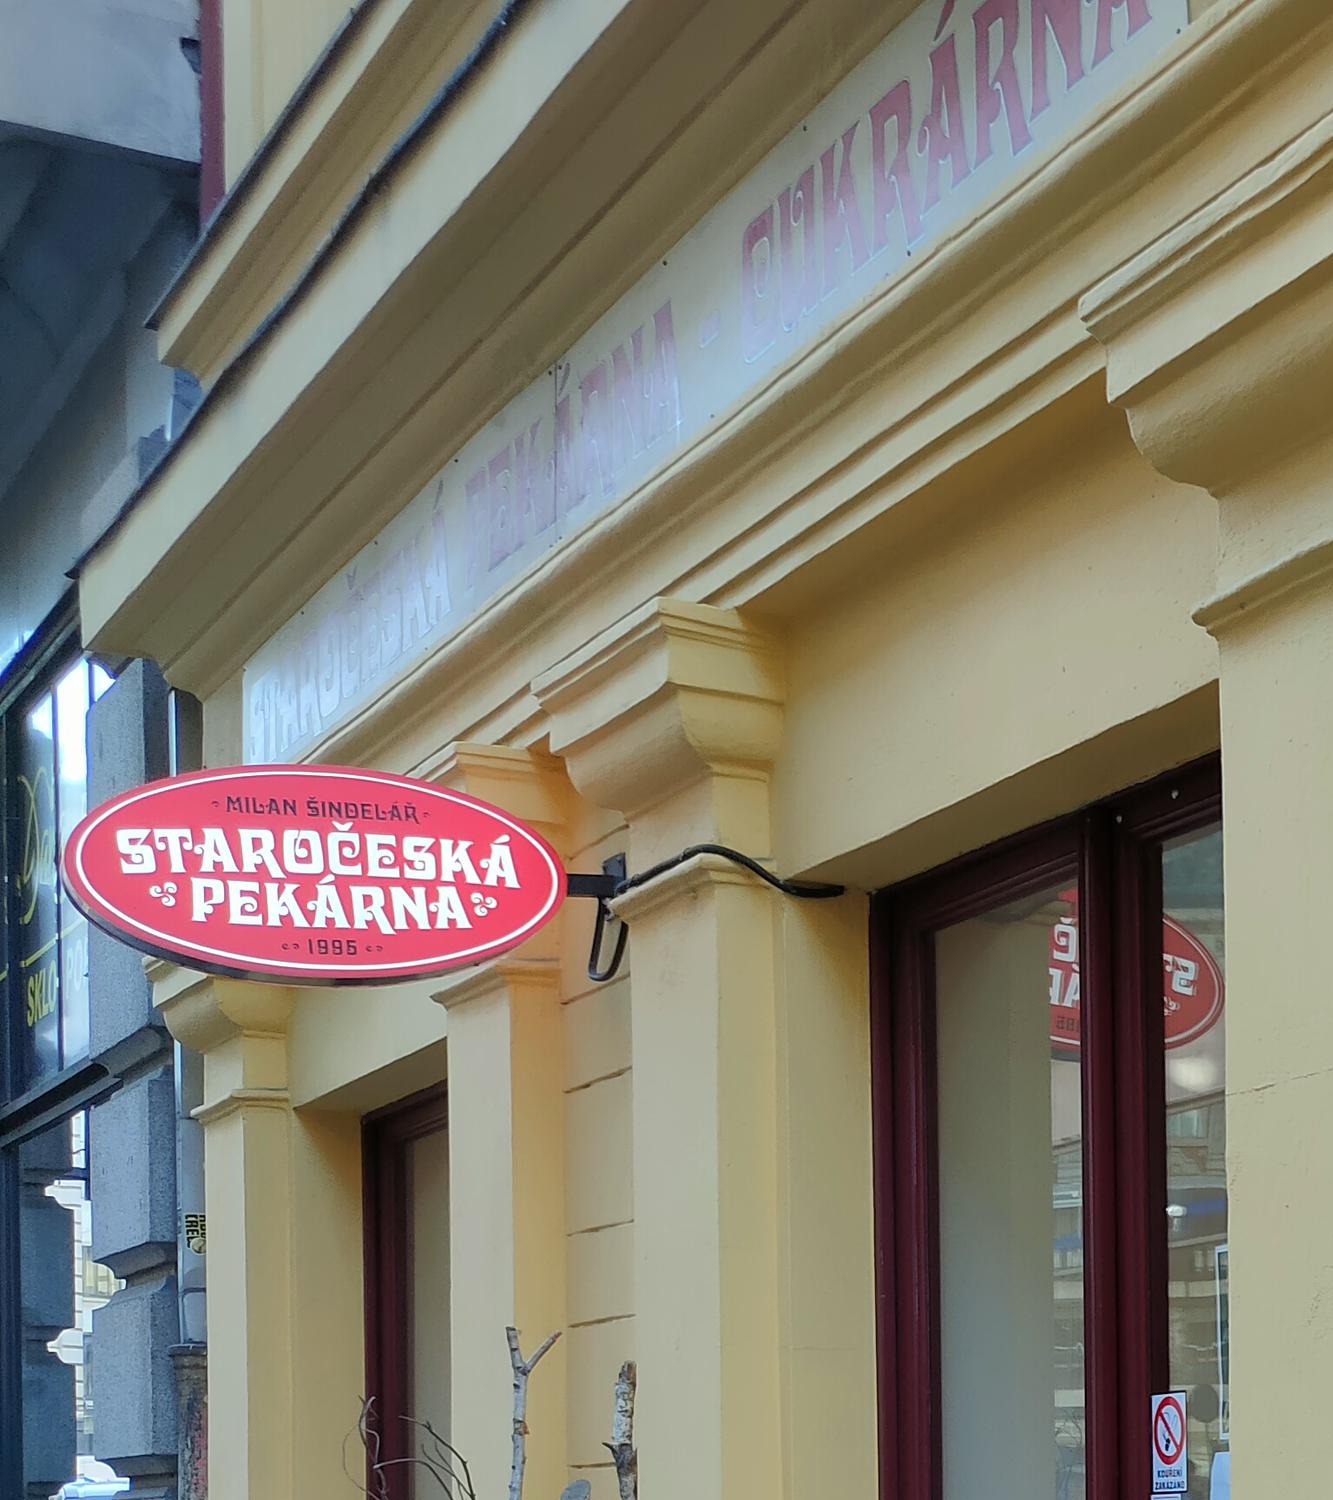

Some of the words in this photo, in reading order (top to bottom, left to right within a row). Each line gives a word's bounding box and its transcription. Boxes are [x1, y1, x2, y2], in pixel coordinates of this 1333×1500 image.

[226, 796, 297, 817] MILAN
[306, 796, 419, 824] ŠINDELÁŘ
[116, 821, 521, 889] STAROČESKÁ
[191, 873, 472, 935] PEKÁRNA
[307, 939, 358, 956] 1995
[27, 959, 57, 1027] SKLO
